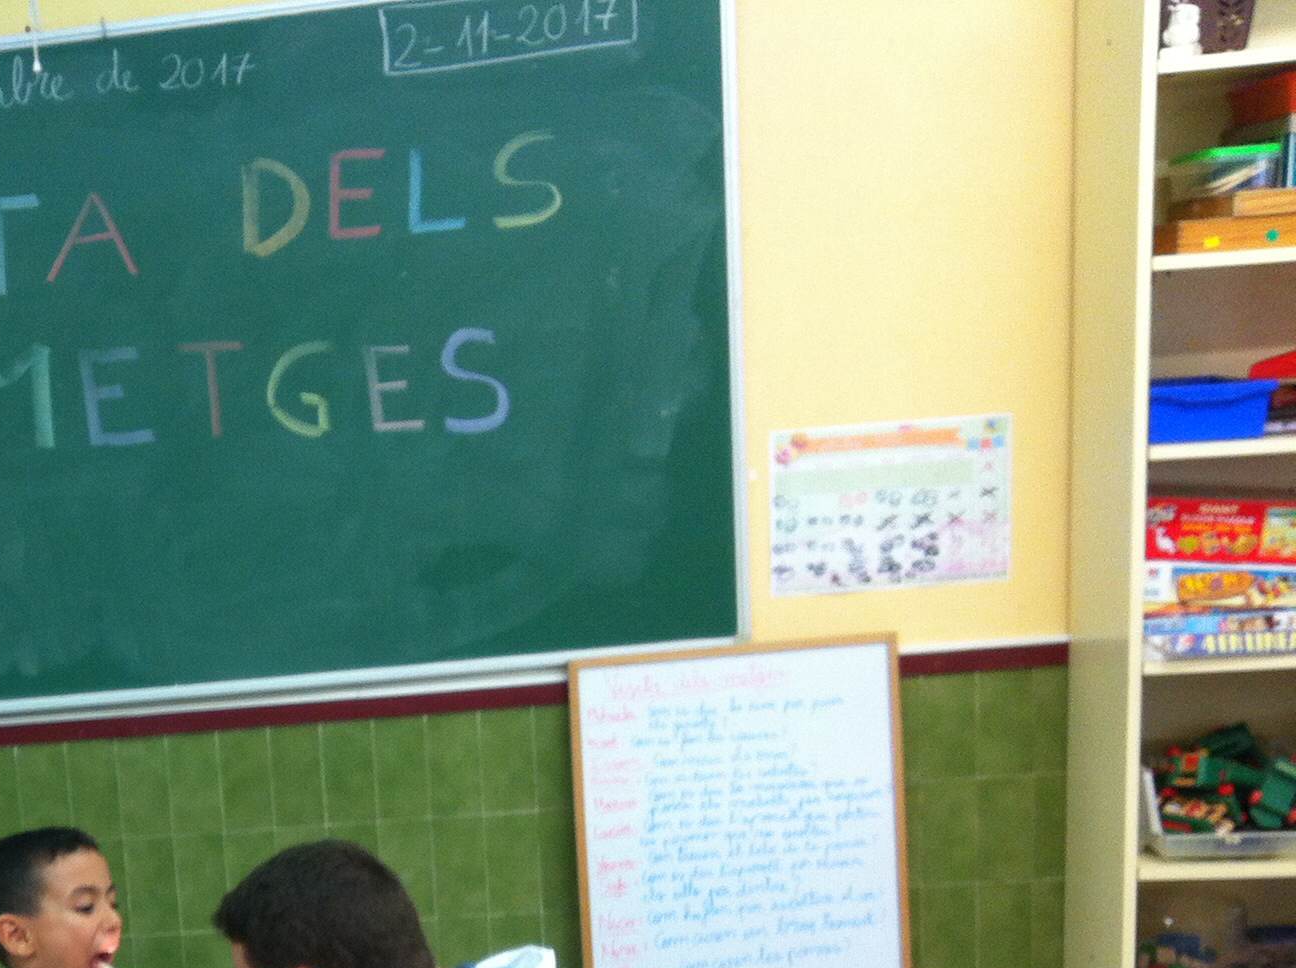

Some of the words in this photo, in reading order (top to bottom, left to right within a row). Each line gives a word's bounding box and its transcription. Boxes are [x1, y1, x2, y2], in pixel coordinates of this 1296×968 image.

[95, 50, 140, 93] de
[158, 51, 256, 91] 2017
[242, 131, 562, 257] DELS
